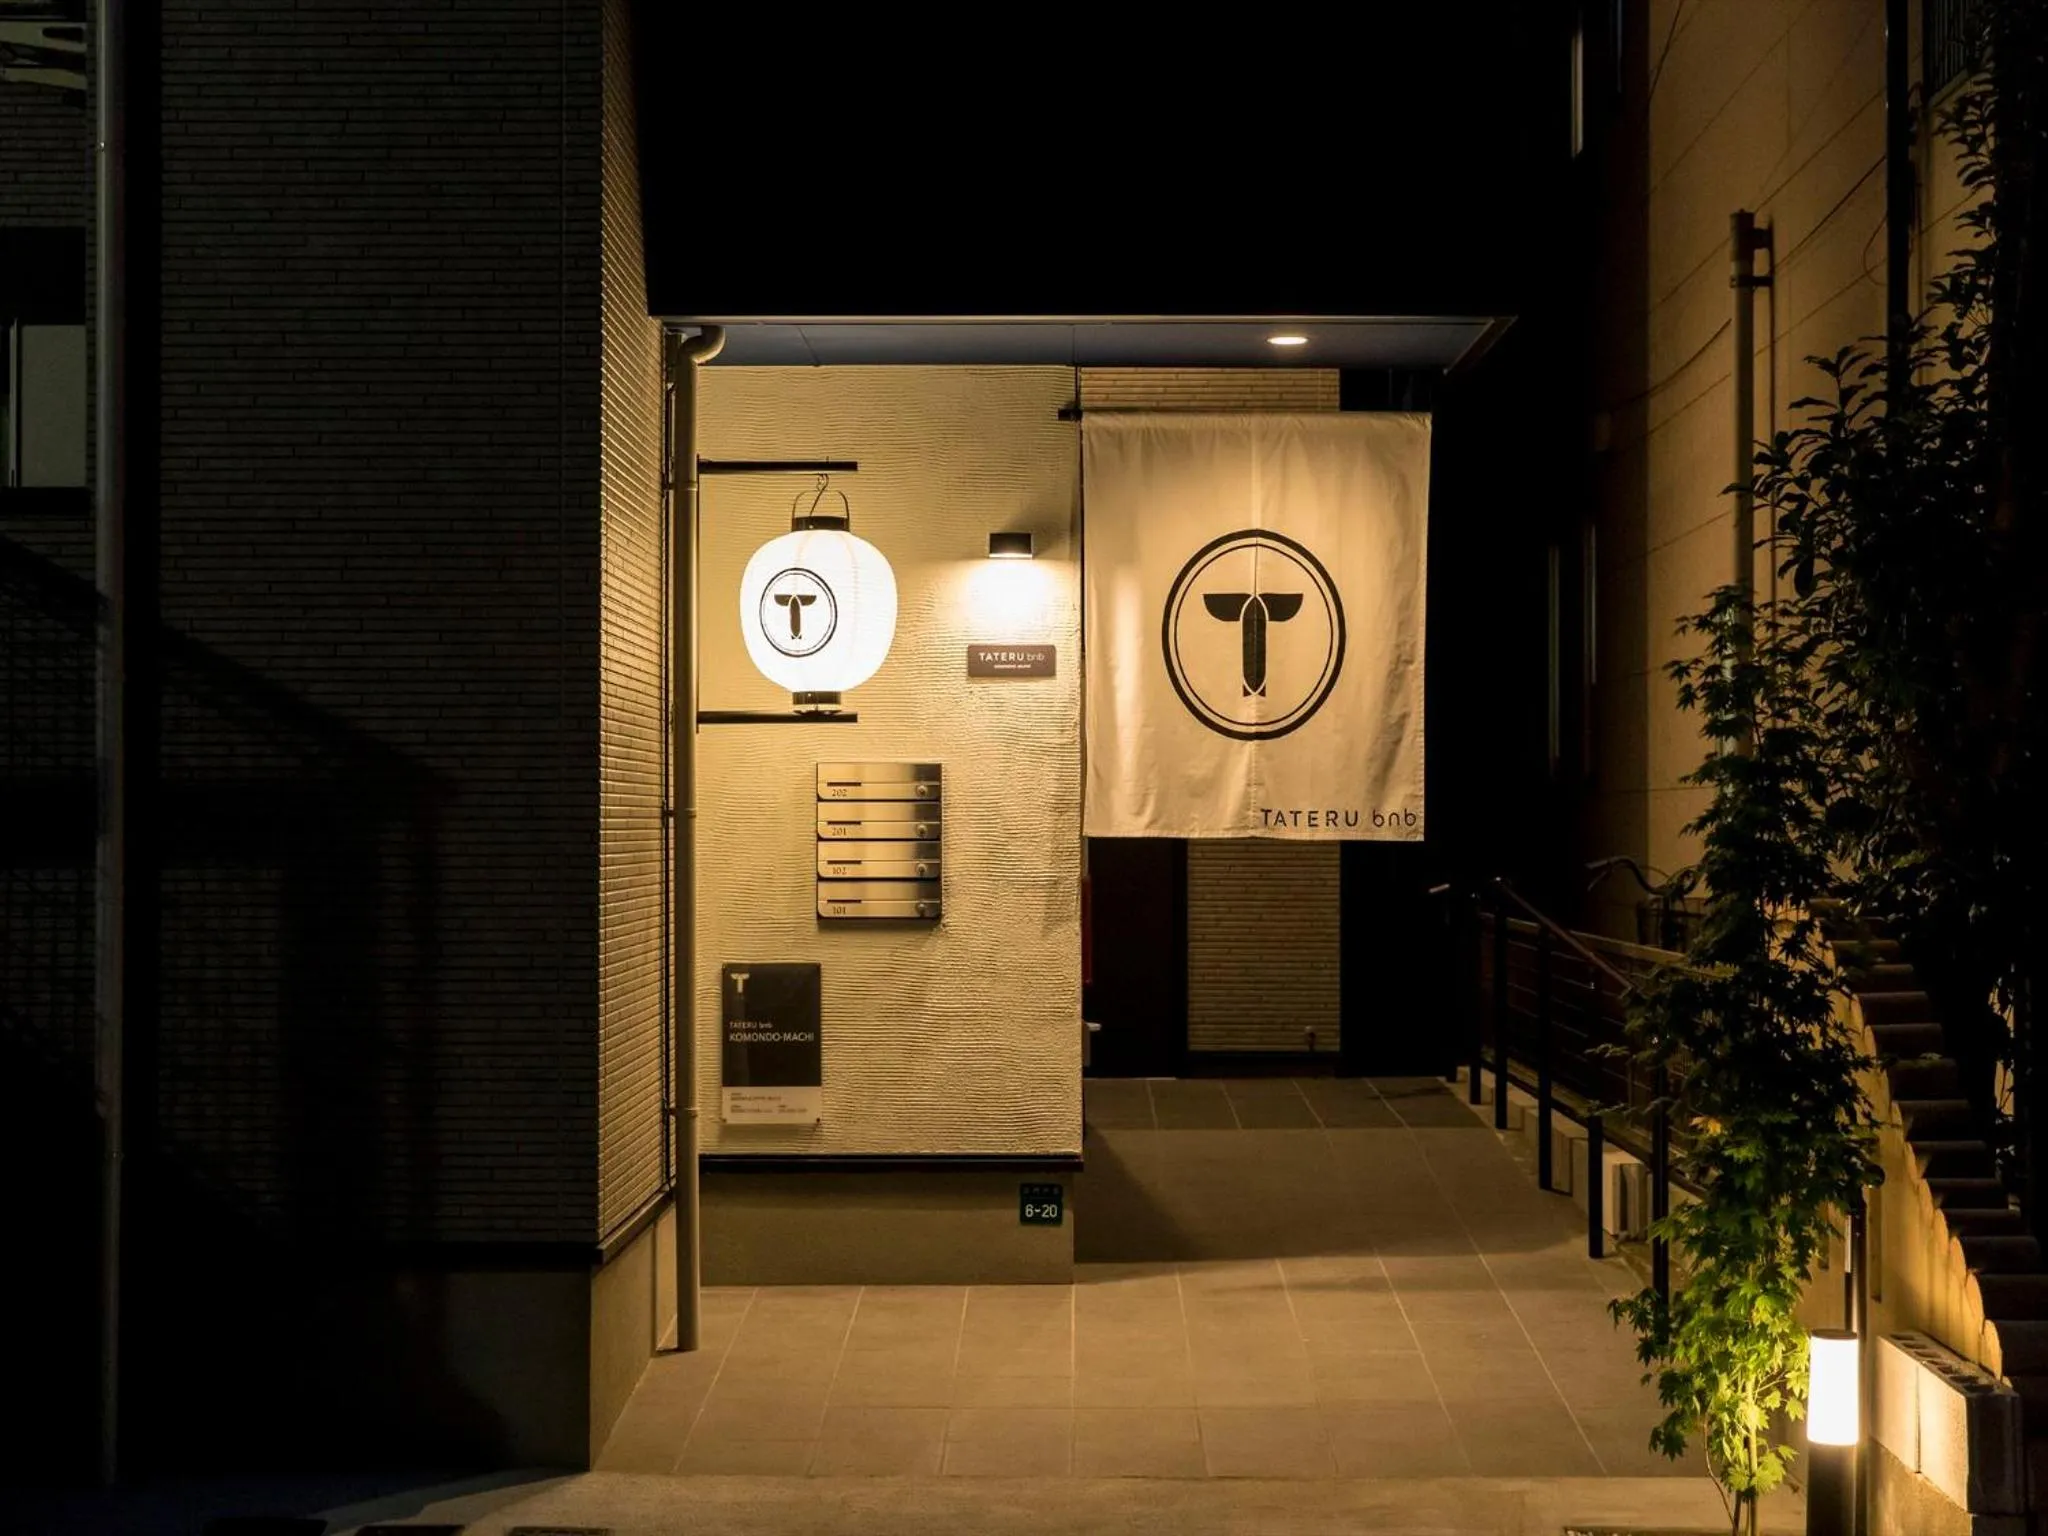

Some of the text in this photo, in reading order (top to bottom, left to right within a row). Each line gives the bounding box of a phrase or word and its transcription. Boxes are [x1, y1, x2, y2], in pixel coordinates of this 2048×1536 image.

[978, 652, 1025, 662] TATERU
[831, 788, 848, 797] 202
[1260, 808, 1418, 828] TATERU bnb
[831, 827, 847, 836] 201
[832, 866, 847, 875] 102
[832, 905, 847, 914] 101
[1024, 1203, 1058, 1218] 6-20
